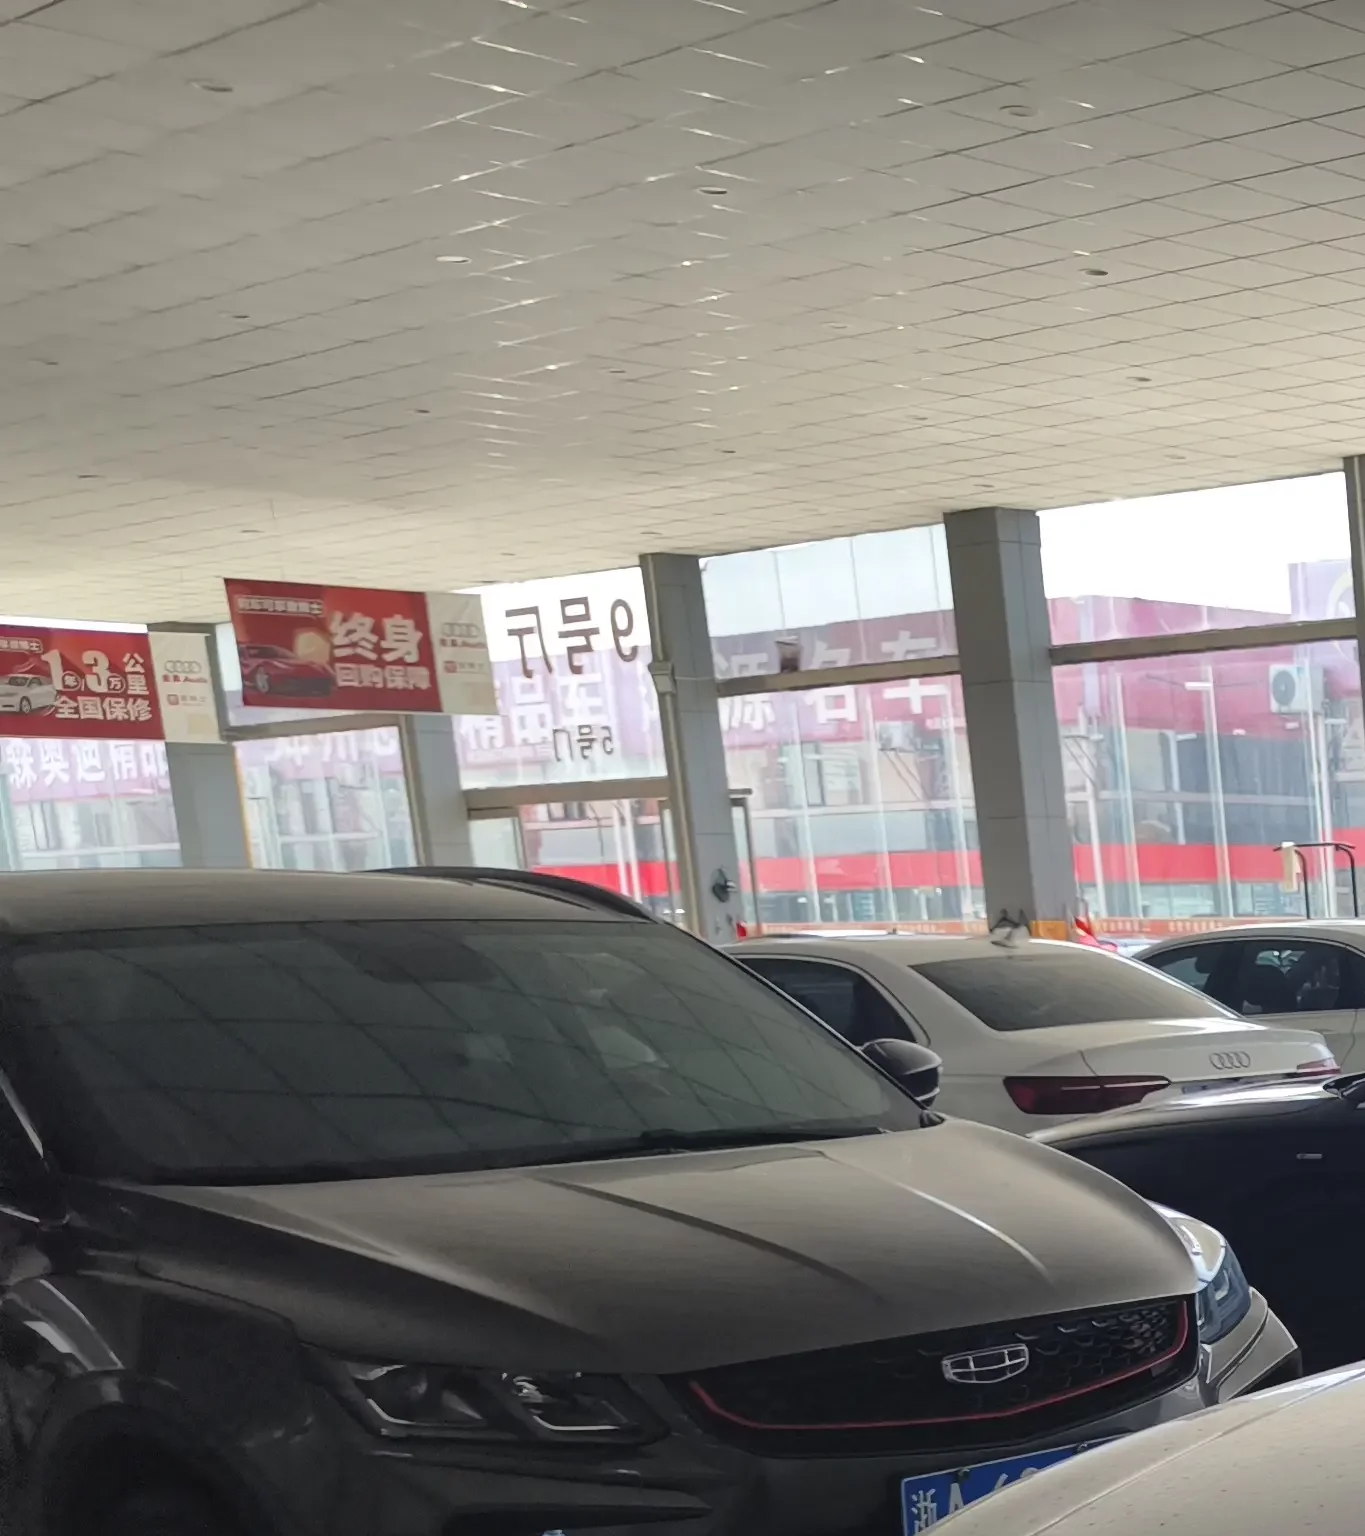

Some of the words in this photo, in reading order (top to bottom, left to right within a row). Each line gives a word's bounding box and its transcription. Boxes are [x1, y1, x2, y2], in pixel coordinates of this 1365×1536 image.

[329, 611, 423, 663] 终身
[334, 662, 431, 690] 回购保障
[55, 696, 152, 721] 全国保修
